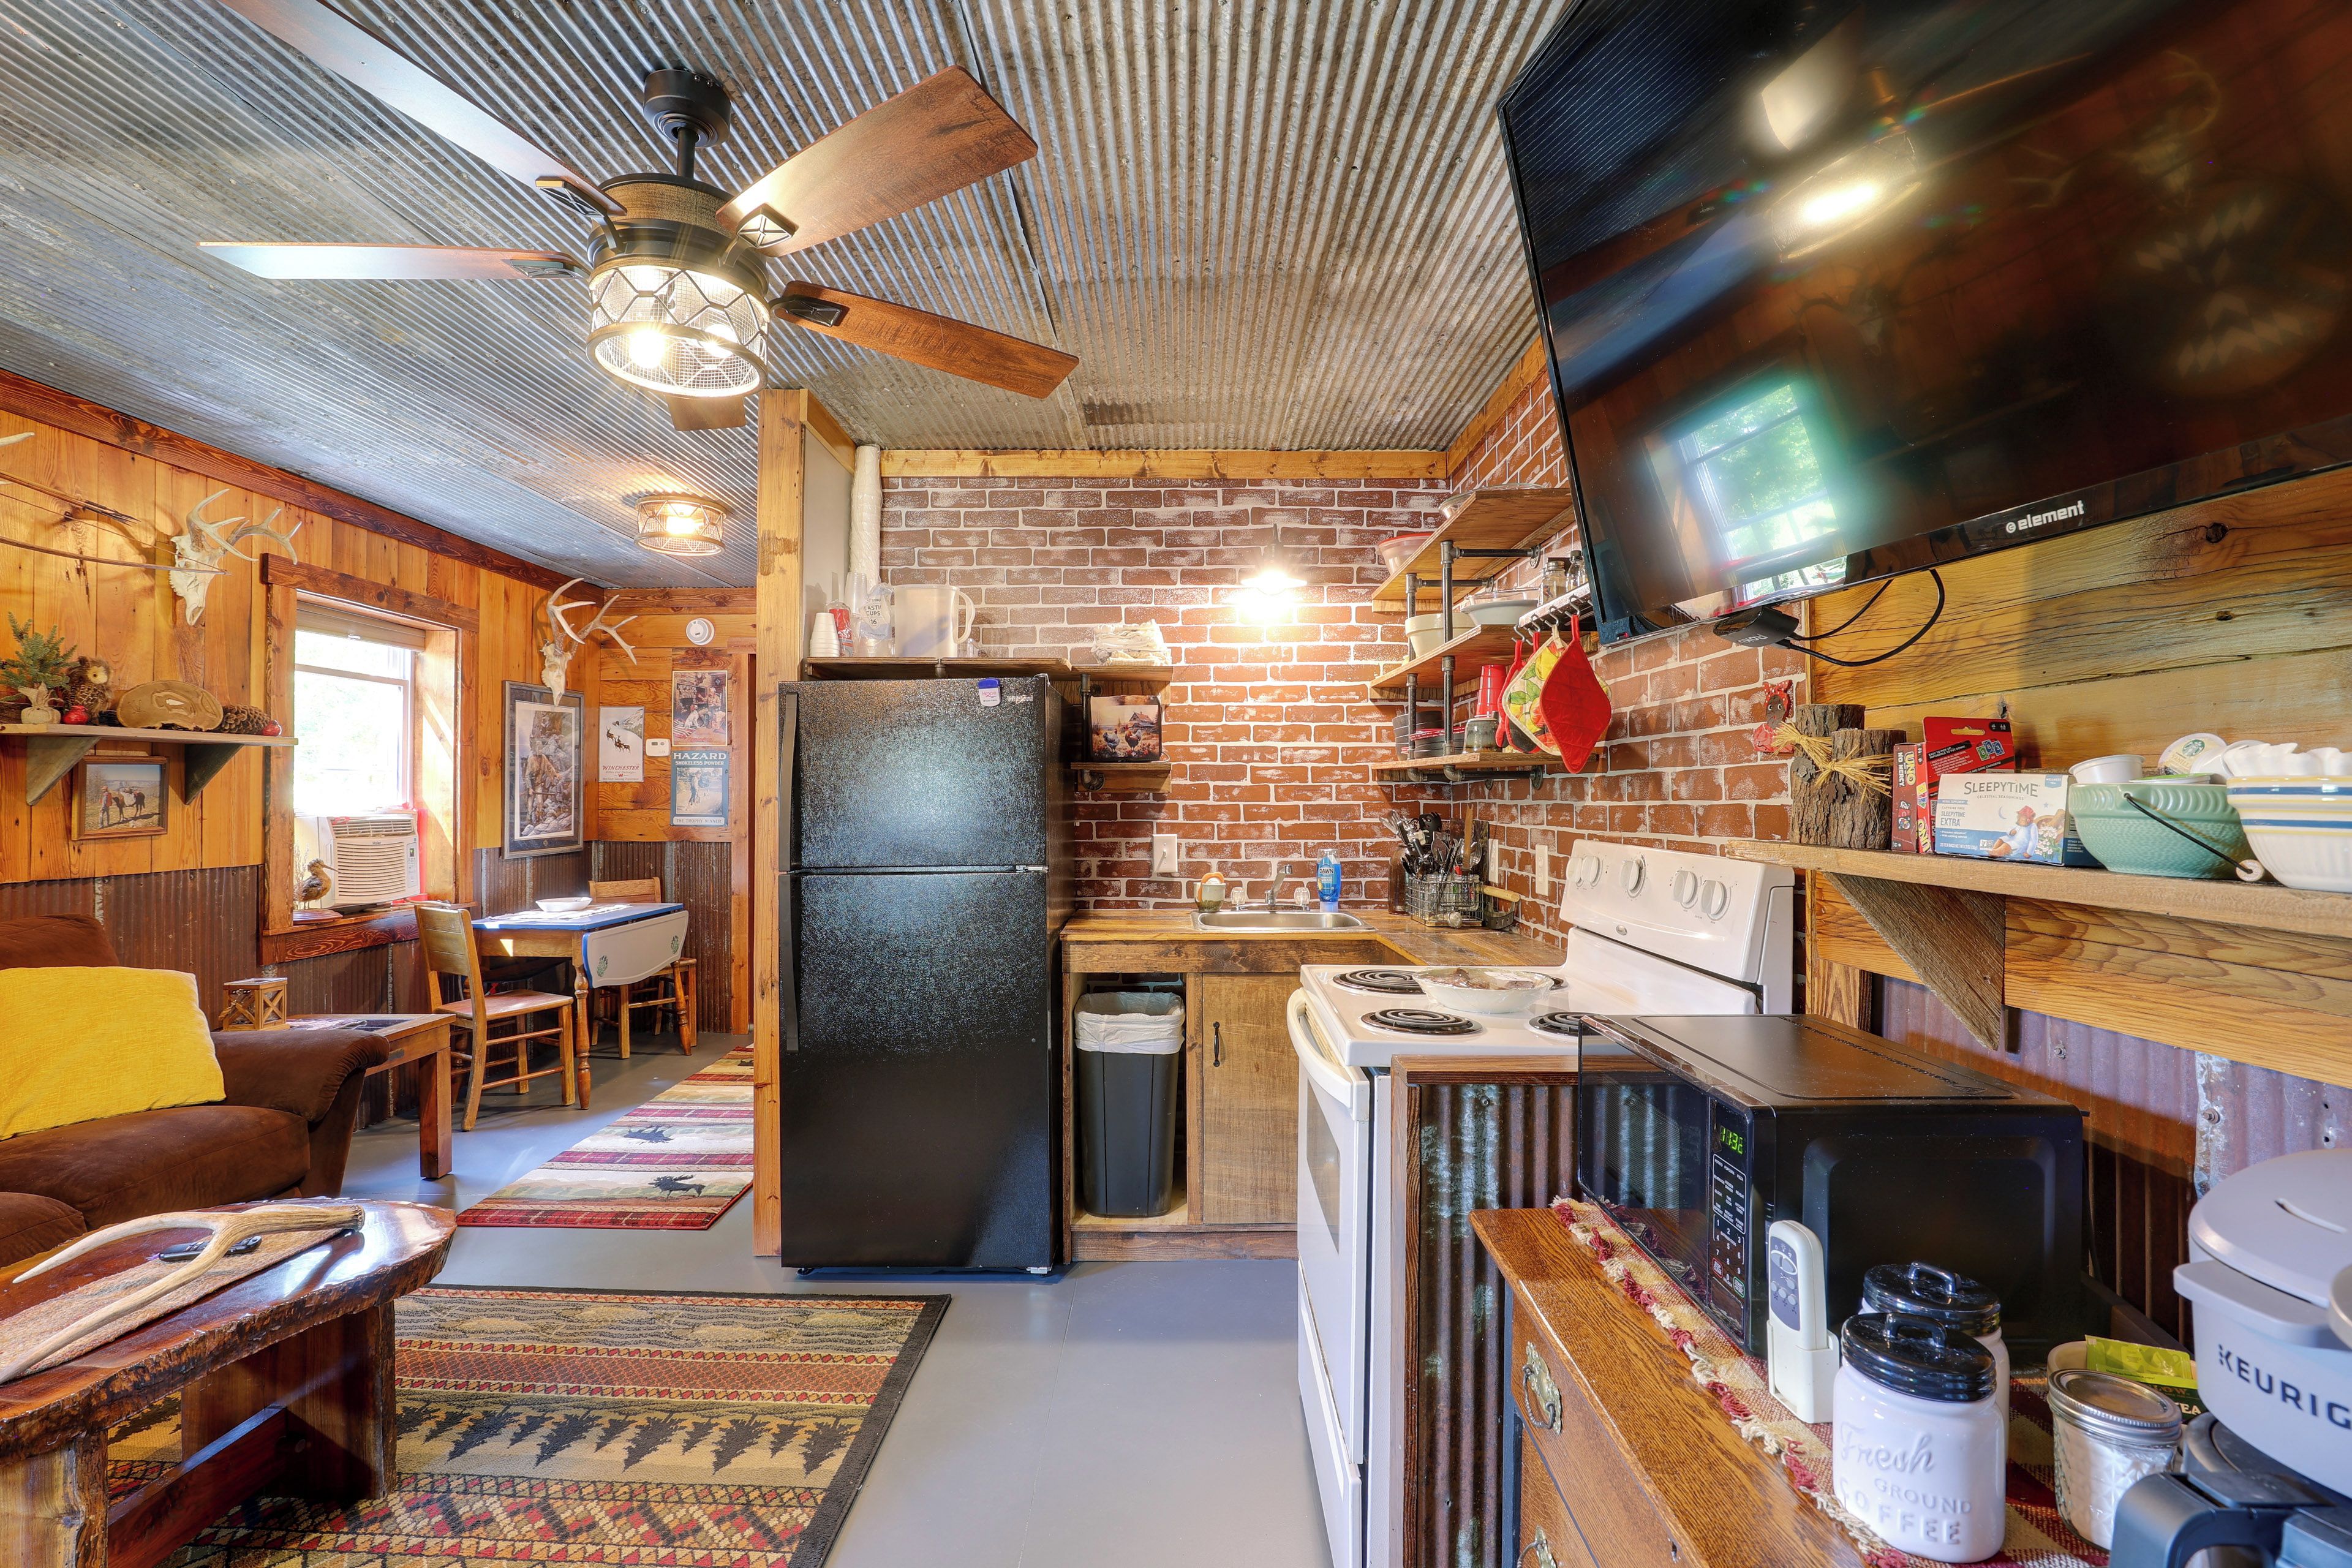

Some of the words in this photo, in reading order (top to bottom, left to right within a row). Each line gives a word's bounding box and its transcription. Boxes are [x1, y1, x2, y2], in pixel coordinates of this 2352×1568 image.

[2018, 500, 2084, 530] element
[1898, 752, 1904, 764] NO
[1904, 751, 1917, 786] UNO
[2171, 754, 2192, 767] VANILL
[1964, 782, 2039, 797] SLEEPYTIME
[1917, 818, 1931, 853] UNO
[1940, 818, 1960, 827] EXTRA
[2218, 1344, 2352, 1431] KEURIG
[2175, 1401, 2202, 1416] EA
[1841, 1422, 1936, 1474] Fresh
[1840, 1477, 1961, 1545] COFFEE
[1874, 1477, 1973, 1515] GROUND
